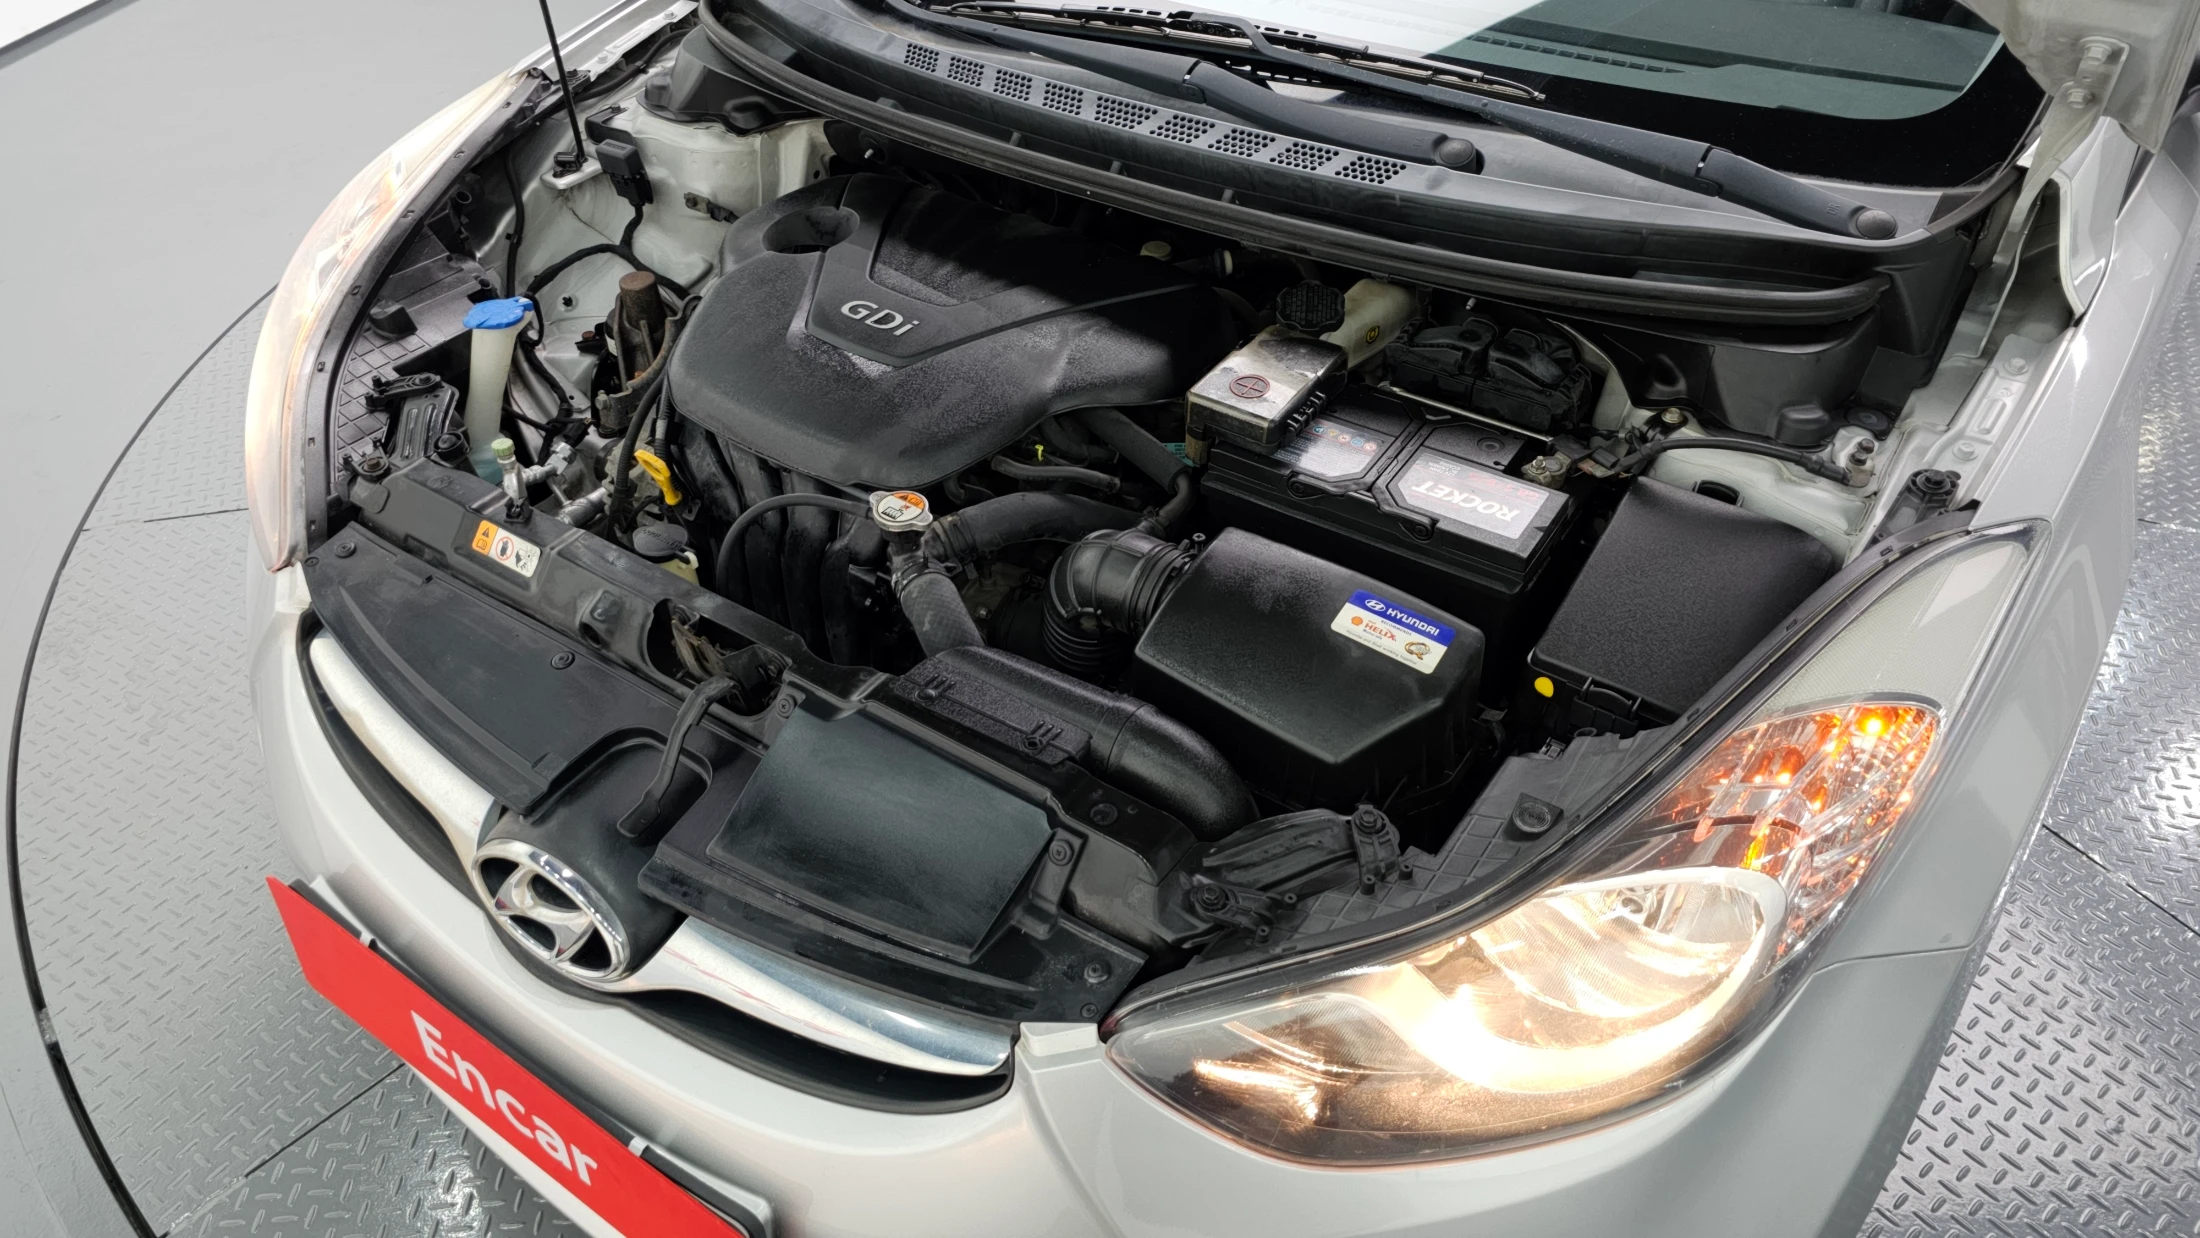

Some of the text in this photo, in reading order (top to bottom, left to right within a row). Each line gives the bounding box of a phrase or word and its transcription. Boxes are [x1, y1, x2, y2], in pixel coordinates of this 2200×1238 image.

[841, 301, 920, 336] GDi
[1412, 481, 1521, 522] ROCKET
[1365, 622, 1397, 642] HELIX
[1386, 607, 1440, 636] HYUNDAI
[410, 1009, 598, 1187] Encar
